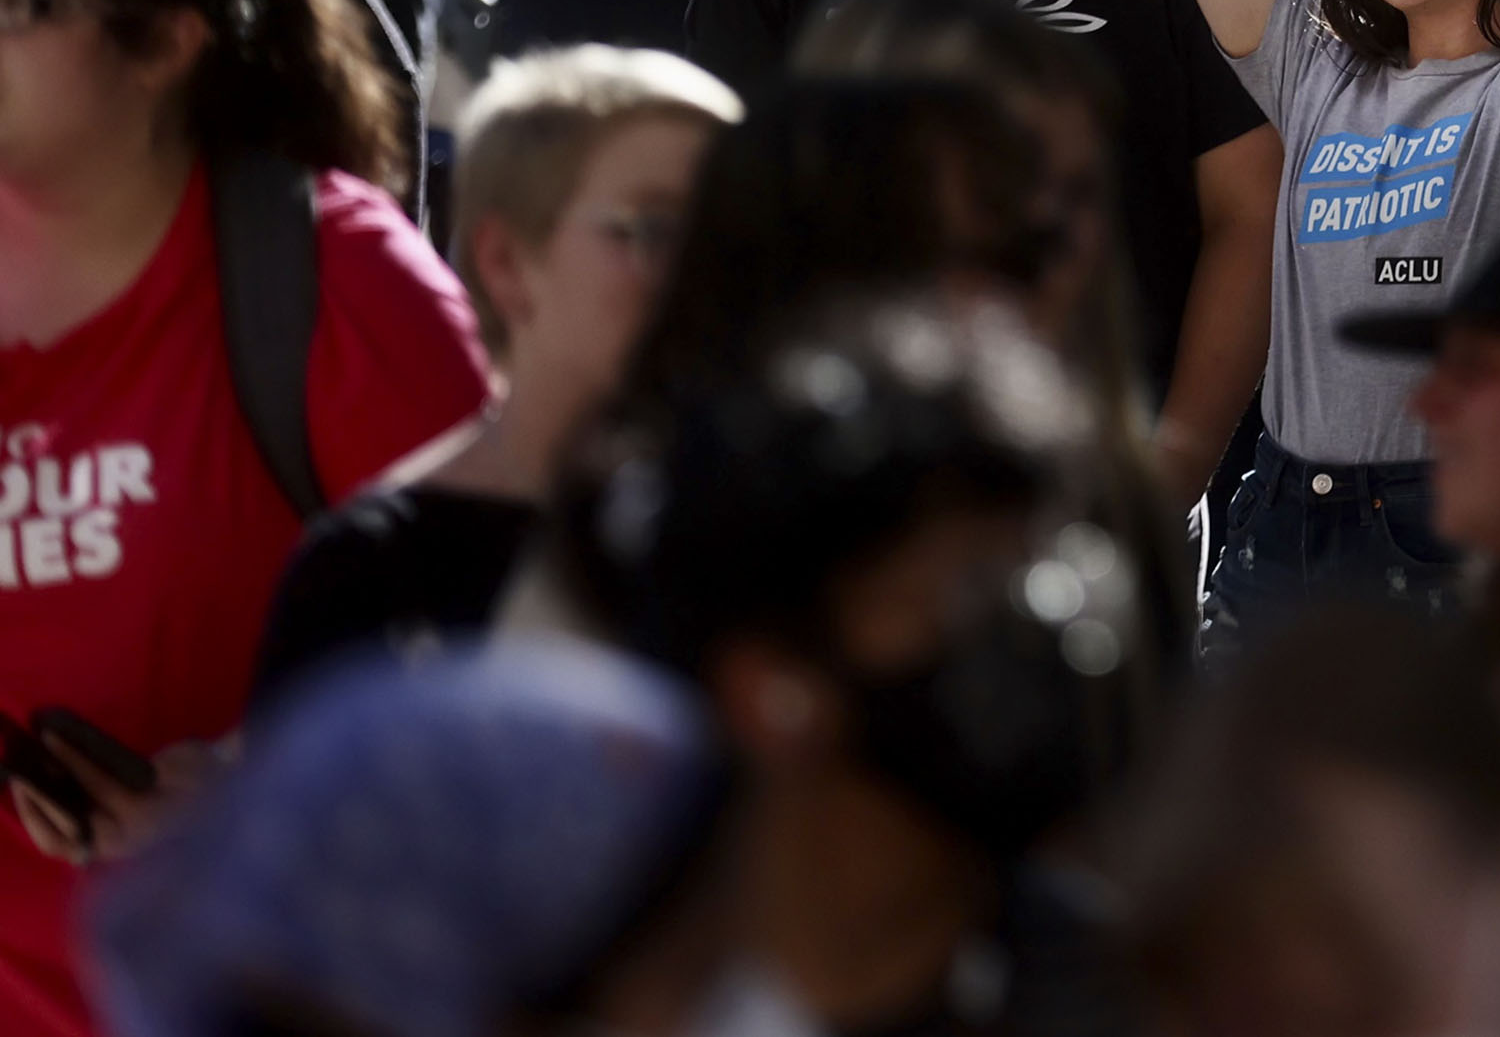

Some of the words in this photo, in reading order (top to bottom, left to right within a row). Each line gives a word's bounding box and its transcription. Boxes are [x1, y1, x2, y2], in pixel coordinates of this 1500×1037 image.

[1308, 132, 1425, 175] DISSNT
[1424, 124, 1461, 157] IS
[1378, 259, 1440, 283] ACLU
